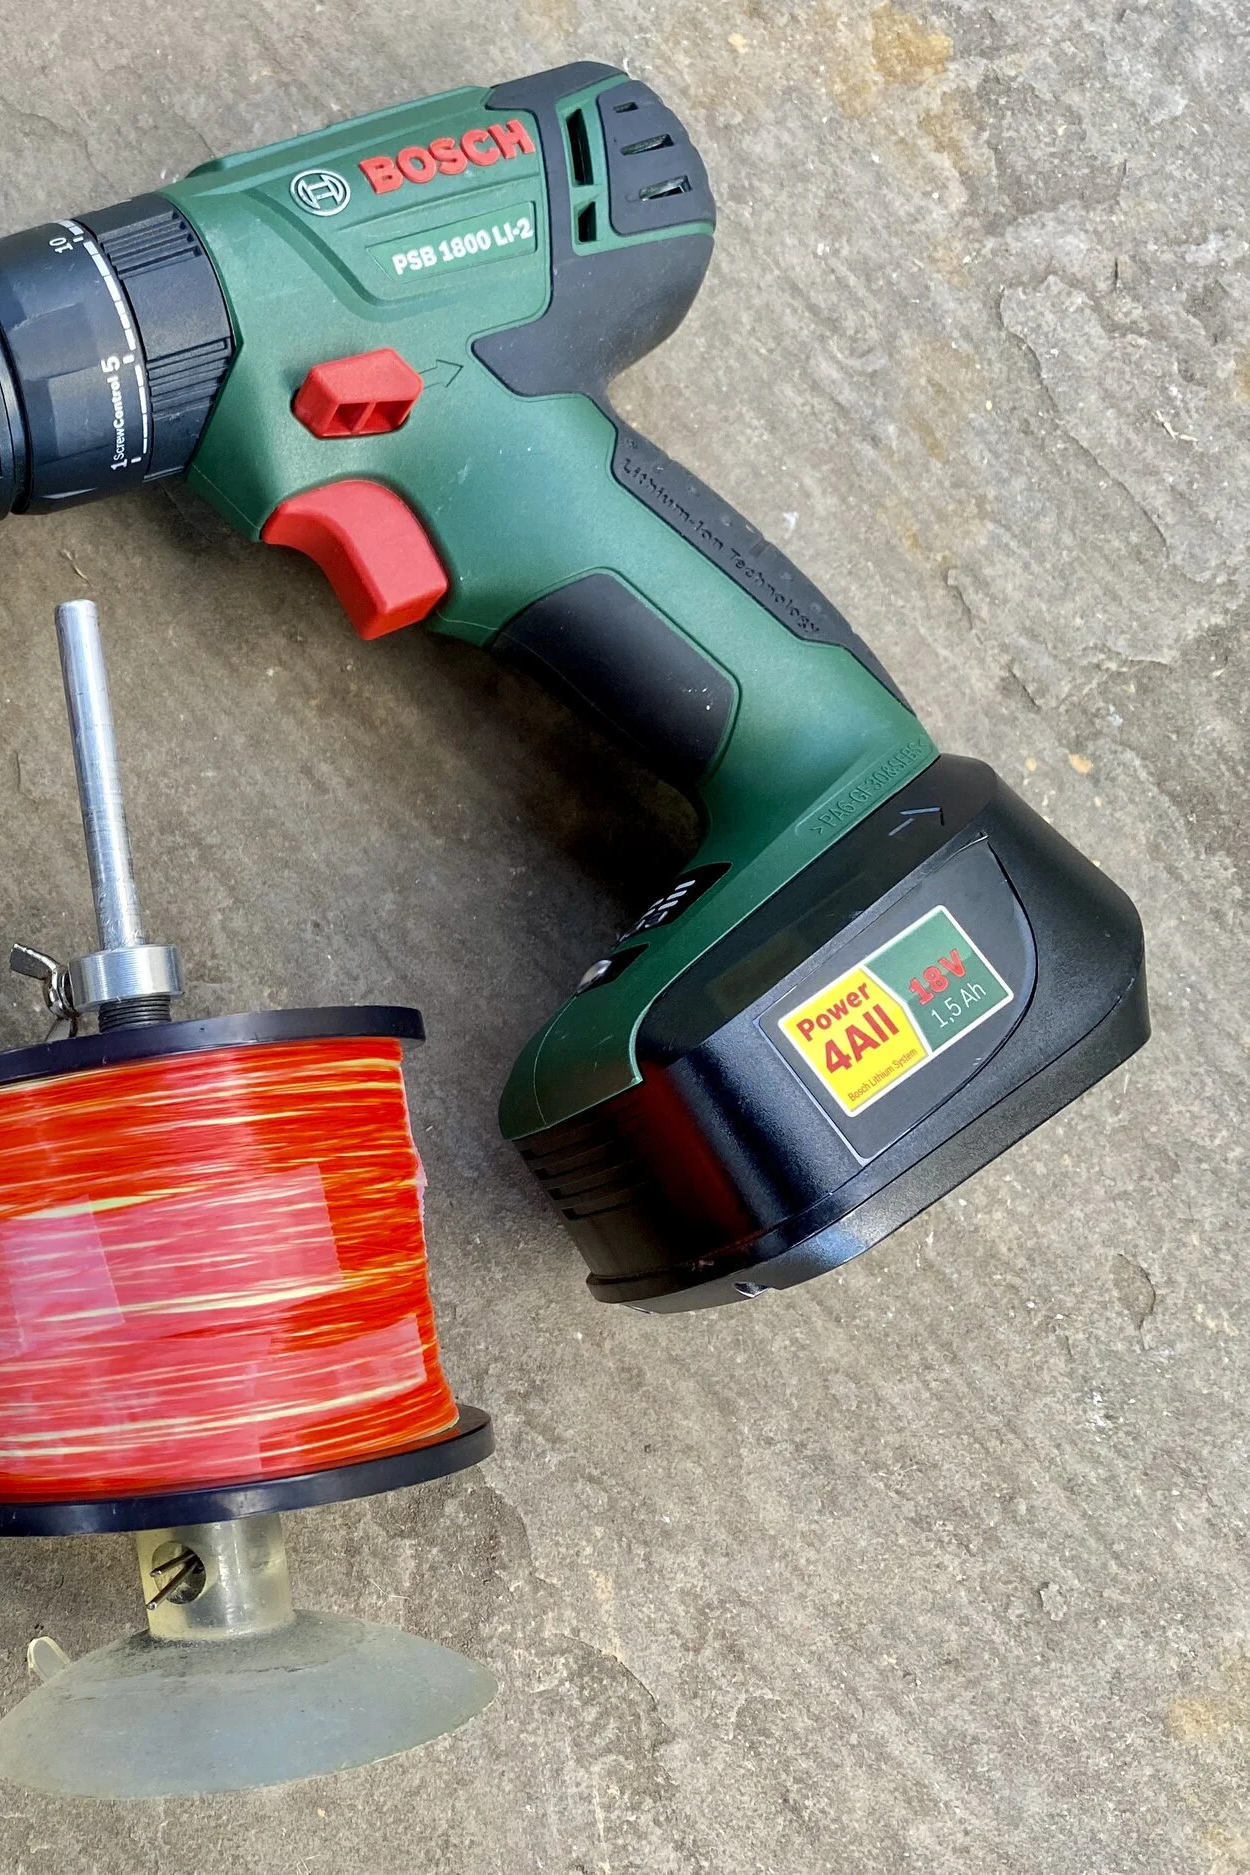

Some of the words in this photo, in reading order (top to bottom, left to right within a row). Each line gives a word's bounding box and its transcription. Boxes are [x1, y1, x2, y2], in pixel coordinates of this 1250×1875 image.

[358, 118, 536, 195] BOSCH
[49, 237, 73, 254] 10
[391, 244, 438, 276] PSB
[439, 229, 492, 264] 1800
[100, 356, 121, 373] 5
[908, 948, 966, 1005] 18V
[796, 981, 870, 1042] Power
[931, 997, 962, 1029] 1,5
[960, 982, 987, 1009] Ah
[824, 1003, 900, 1075] 4All
[847, 1081, 871, 1102] Bosch
[868, 1063, 894, 1088] Lithium
[892, 1047, 918, 1071] System
